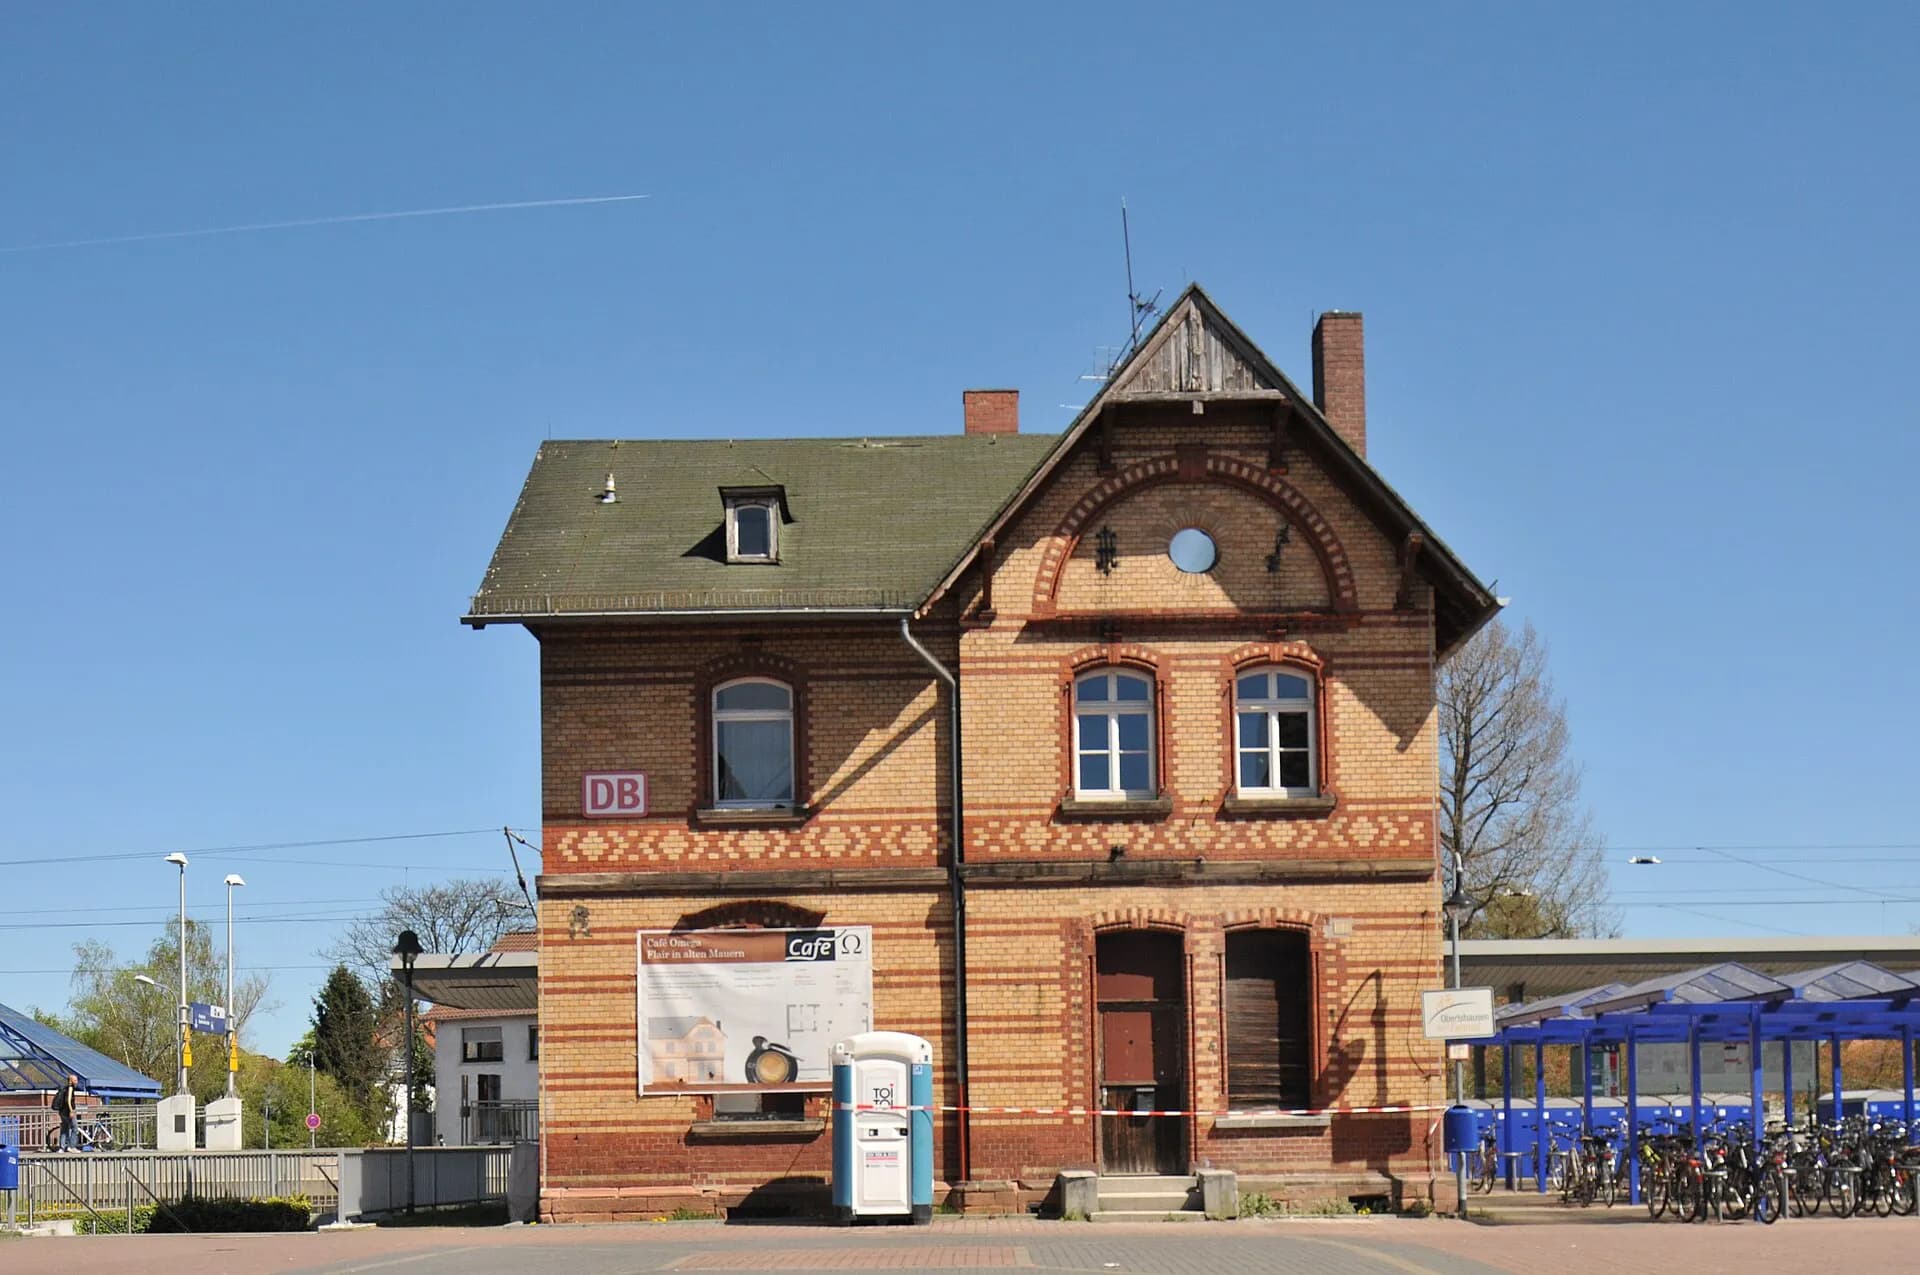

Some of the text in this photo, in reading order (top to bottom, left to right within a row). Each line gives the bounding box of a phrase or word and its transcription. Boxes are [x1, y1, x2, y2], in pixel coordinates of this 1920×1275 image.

[591, 779, 640, 809] DB
[647, 938, 702, 949] Café Omega
[647, 949, 745, 960] Flair in alten Mauern
